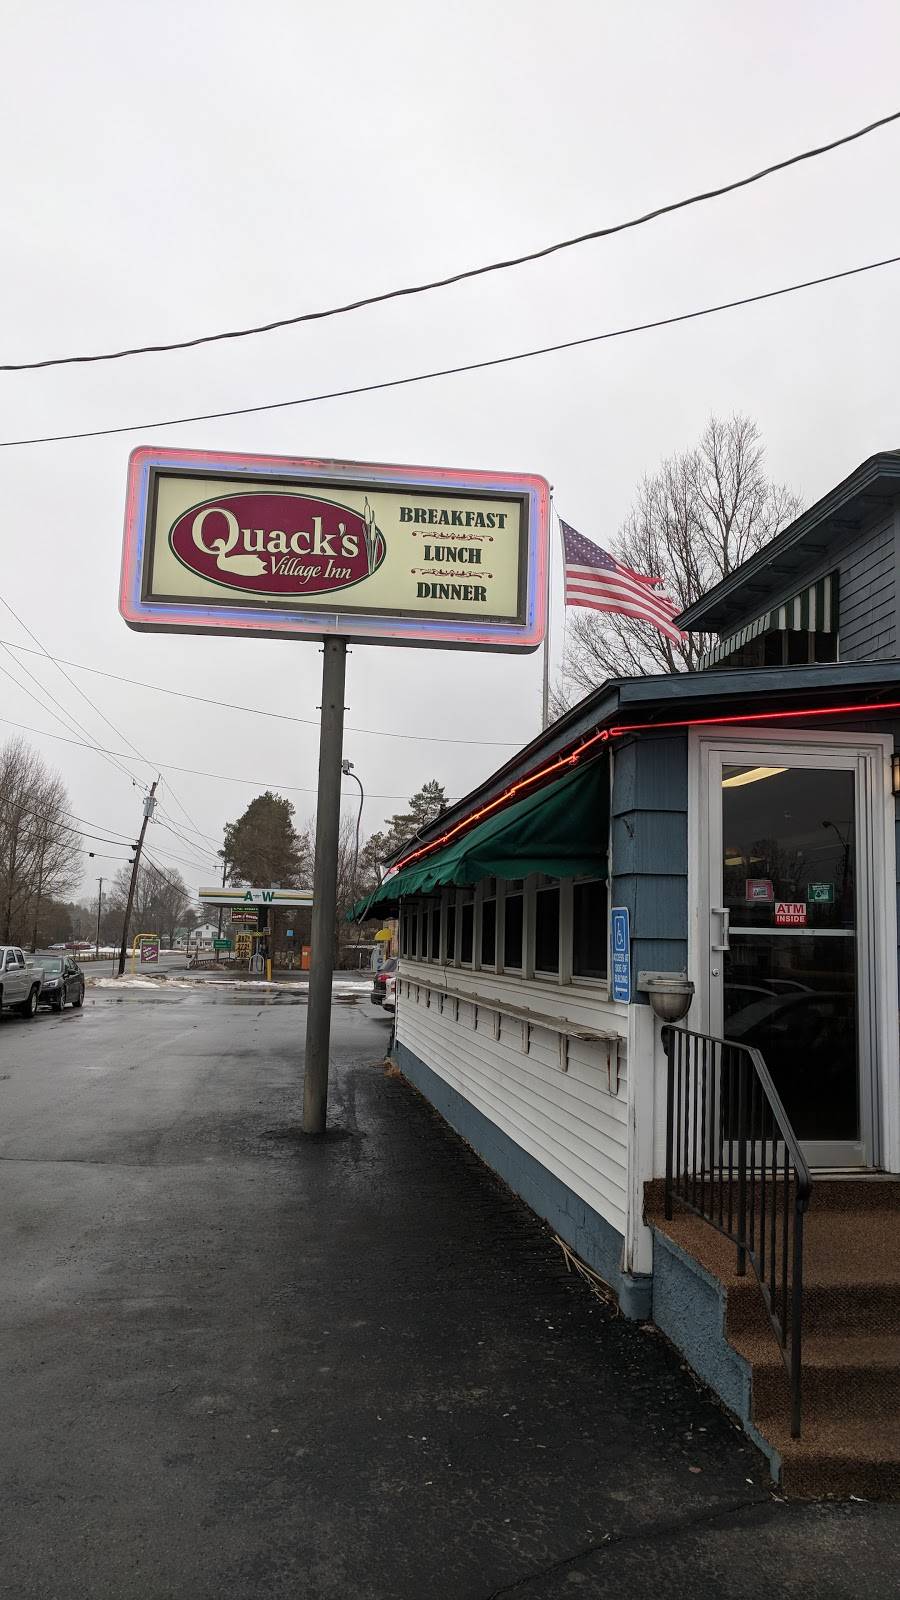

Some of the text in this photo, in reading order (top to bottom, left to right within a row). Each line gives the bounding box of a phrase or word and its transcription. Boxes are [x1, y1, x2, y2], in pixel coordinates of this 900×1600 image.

[399, 506, 508, 529] BREAKFAST
[191, 507, 359, 559] Quack's
[423, 545, 482, 564] LUNCH
[270, 555, 352, 584] Village Inn
[416, 582, 487, 602] DINNER
[776, 915, 805, 923] INSIDE
[777, 904, 804, 914] ATM
